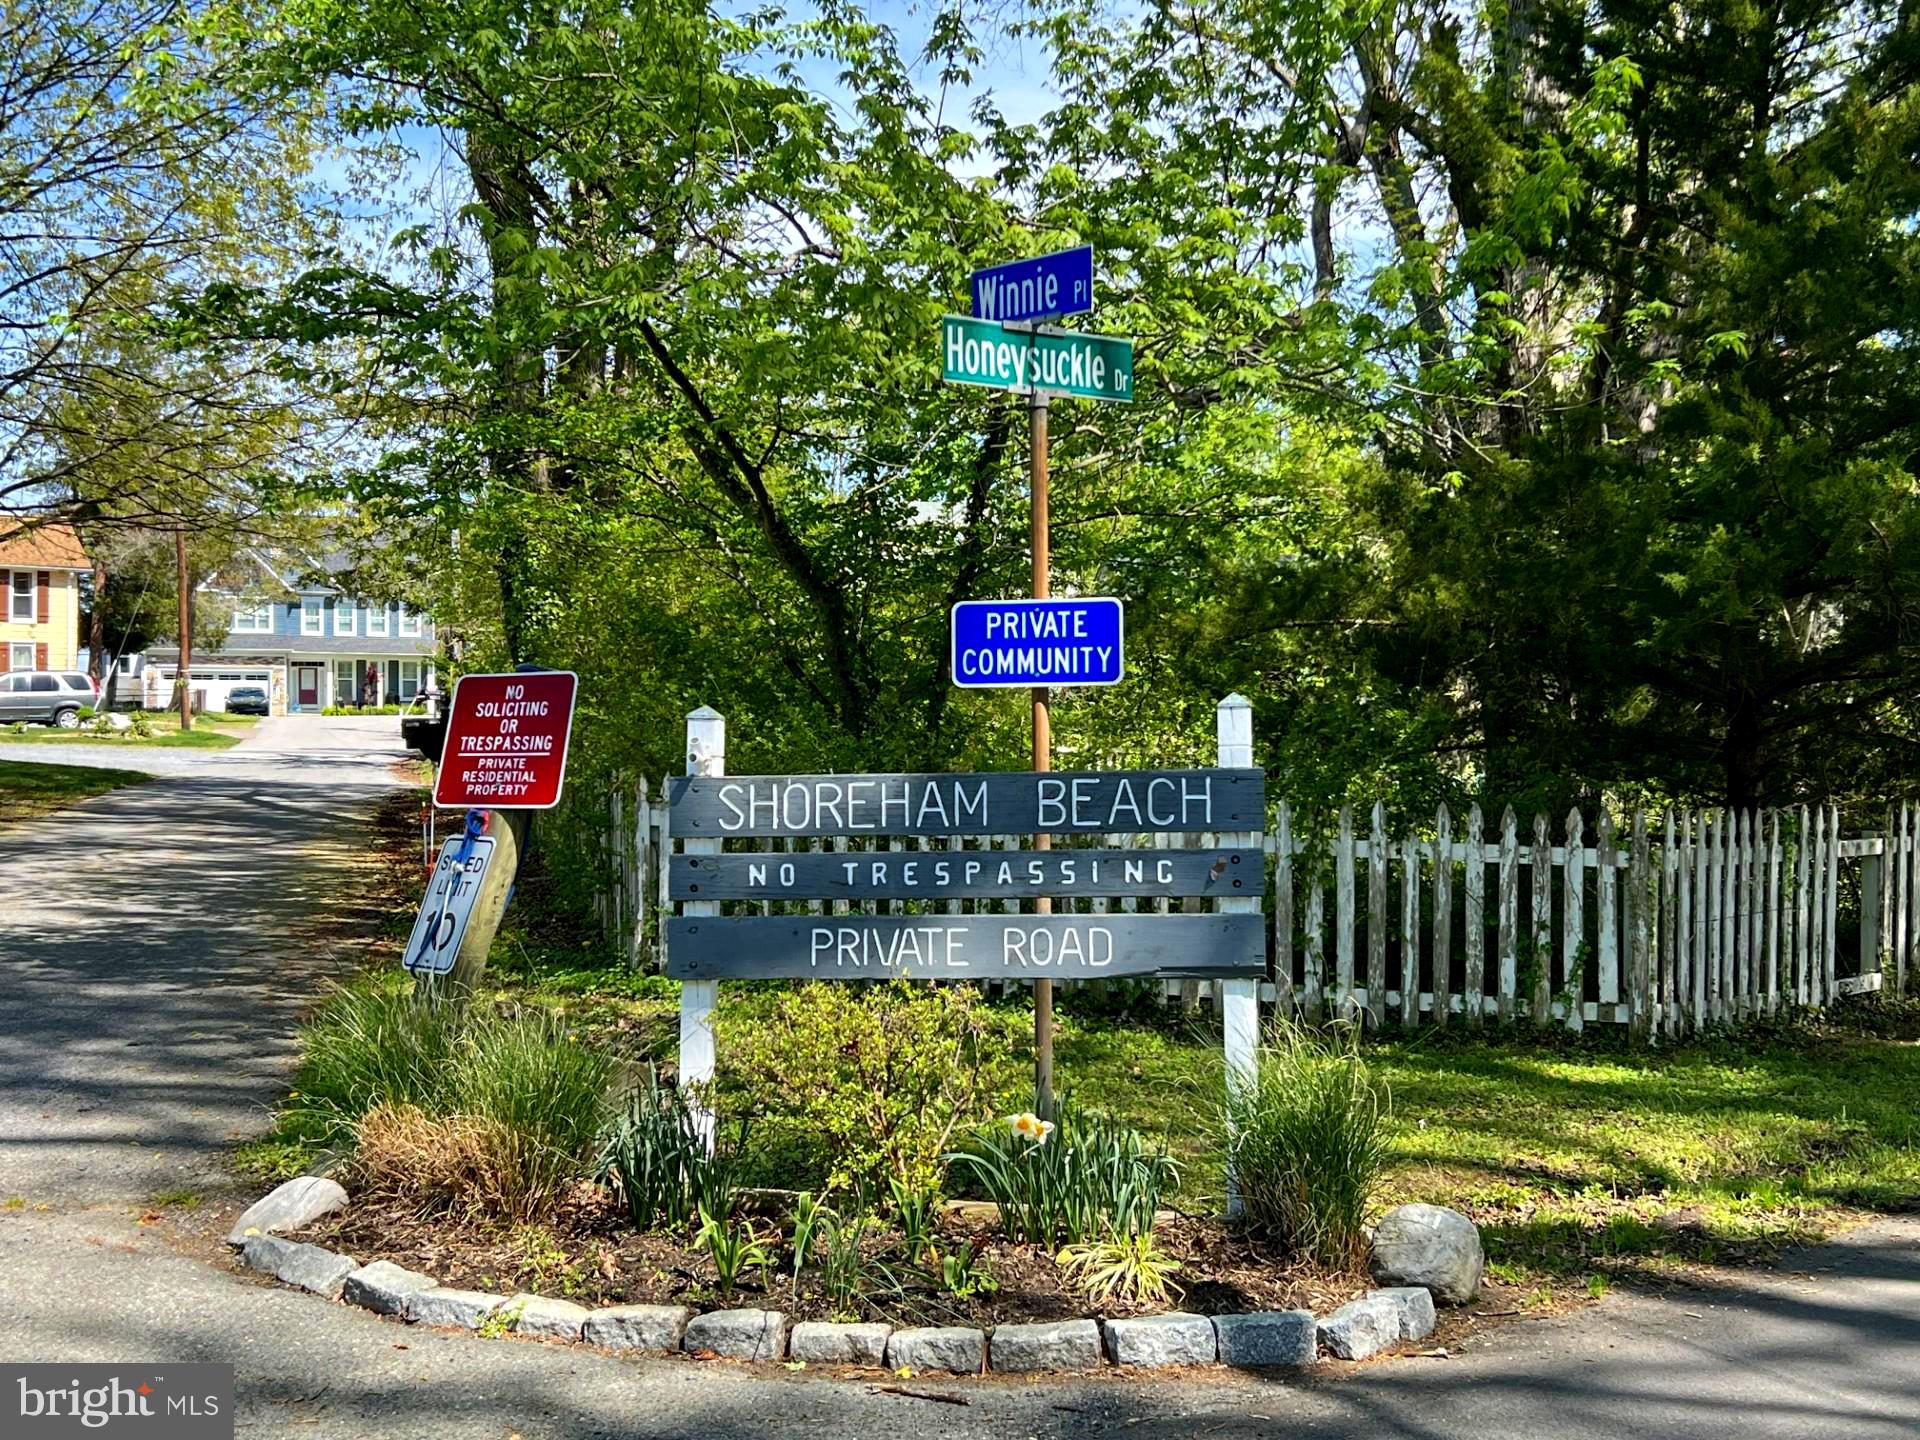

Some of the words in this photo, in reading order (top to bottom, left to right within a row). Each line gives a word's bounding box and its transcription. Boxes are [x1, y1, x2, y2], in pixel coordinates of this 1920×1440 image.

[978, 266, 1058, 320] Winnie
[1074, 279, 1087, 304] Pl
[946, 325, 1105, 389] Honeysuckle
[1114, 369, 1129, 391] Dr
[986, 610, 1088, 639] PRIVATE
[962, 646, 1112, 675] COMMUNITY
[505, 685, 524, 700] NO
[475, 702, 548, 718] SOLICITING
[499, 719, 518, 734] OR
[460, 736, 553, 752] TRESPASSING
[478, 758, 526, 769] PRIVATE
[462, 771, 537, 783] RESIDENTIAL
[466, 784, 528, 796] PROPERTY
[718, 779, 988, 831] SHOREHAM
[1036, 776, 1212, 827] BEACH
[441, 855, 484, 873] SED
[748, 863, 796, 887] NO
[842, 860, 1174, 886] TRESPASSING
[437, 879, 472, 897] LIIT
[810, 927, 969, 967] PRIVATE
[1002, 927, 1113, 967] ROAD
